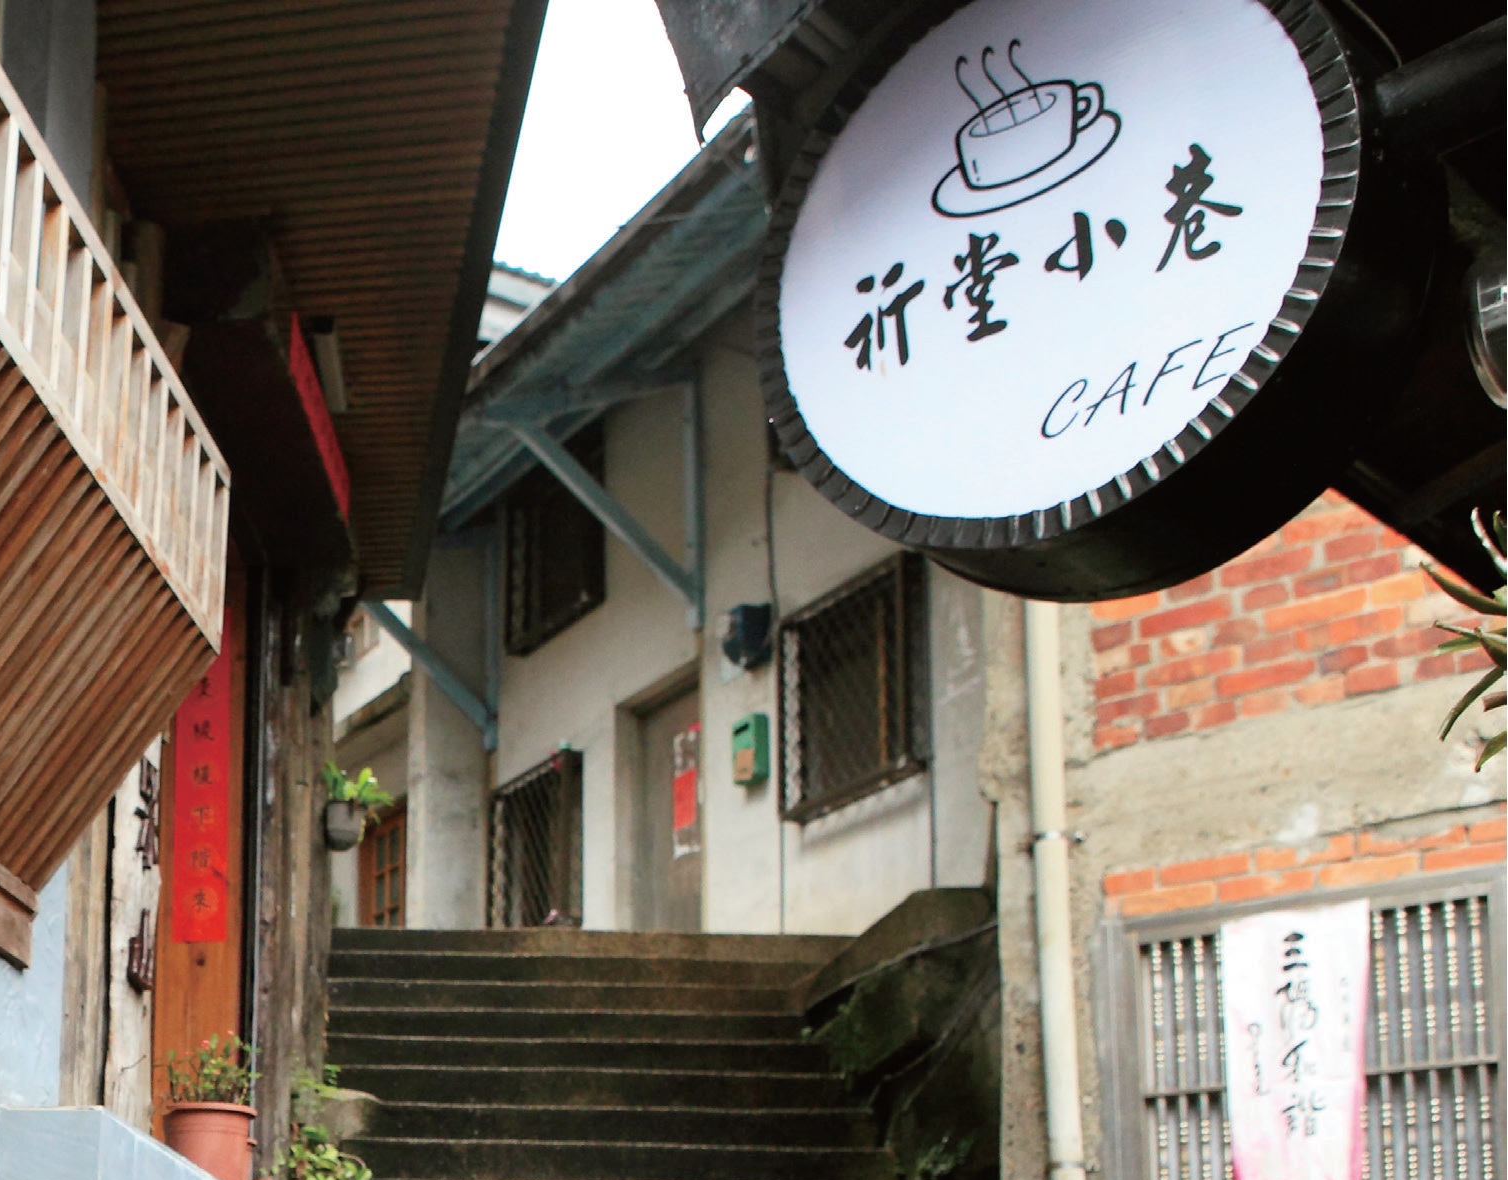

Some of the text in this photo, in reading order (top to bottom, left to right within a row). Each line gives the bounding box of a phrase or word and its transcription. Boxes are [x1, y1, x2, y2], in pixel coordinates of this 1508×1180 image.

[843, 143, 1243, 372] 祈堂小巷
[1040, 321, 1254, 440] CAFE
